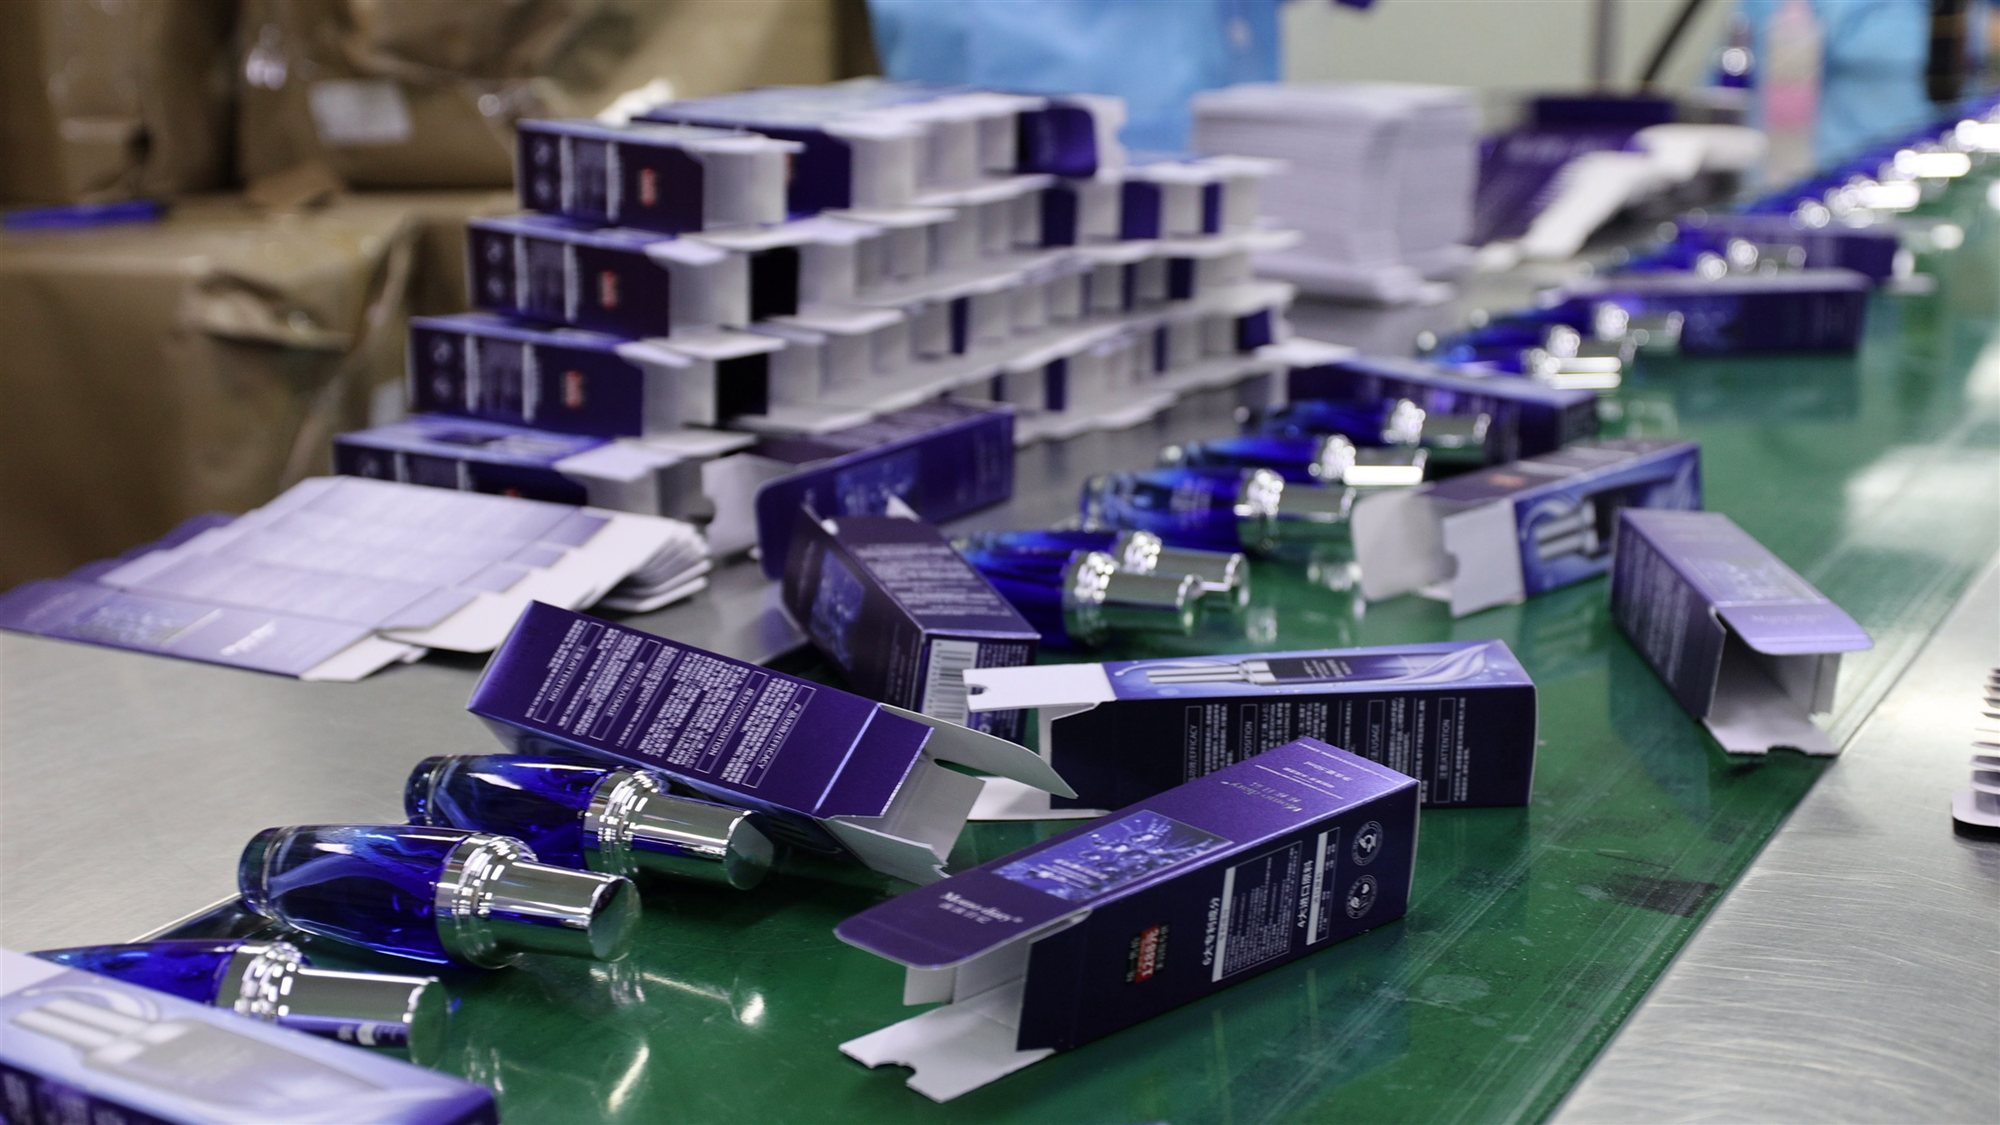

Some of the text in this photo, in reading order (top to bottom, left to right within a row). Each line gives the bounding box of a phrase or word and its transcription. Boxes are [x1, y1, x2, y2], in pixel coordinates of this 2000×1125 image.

[706, 687, 755, 756] 成分/COMPOSITION
[755, 702, 802, 769] 产品功效/EFFICACY
[1296, 858, 1314, 929] 4大进口原料
[1201, 894, 1220, 967] 6大专利成分
